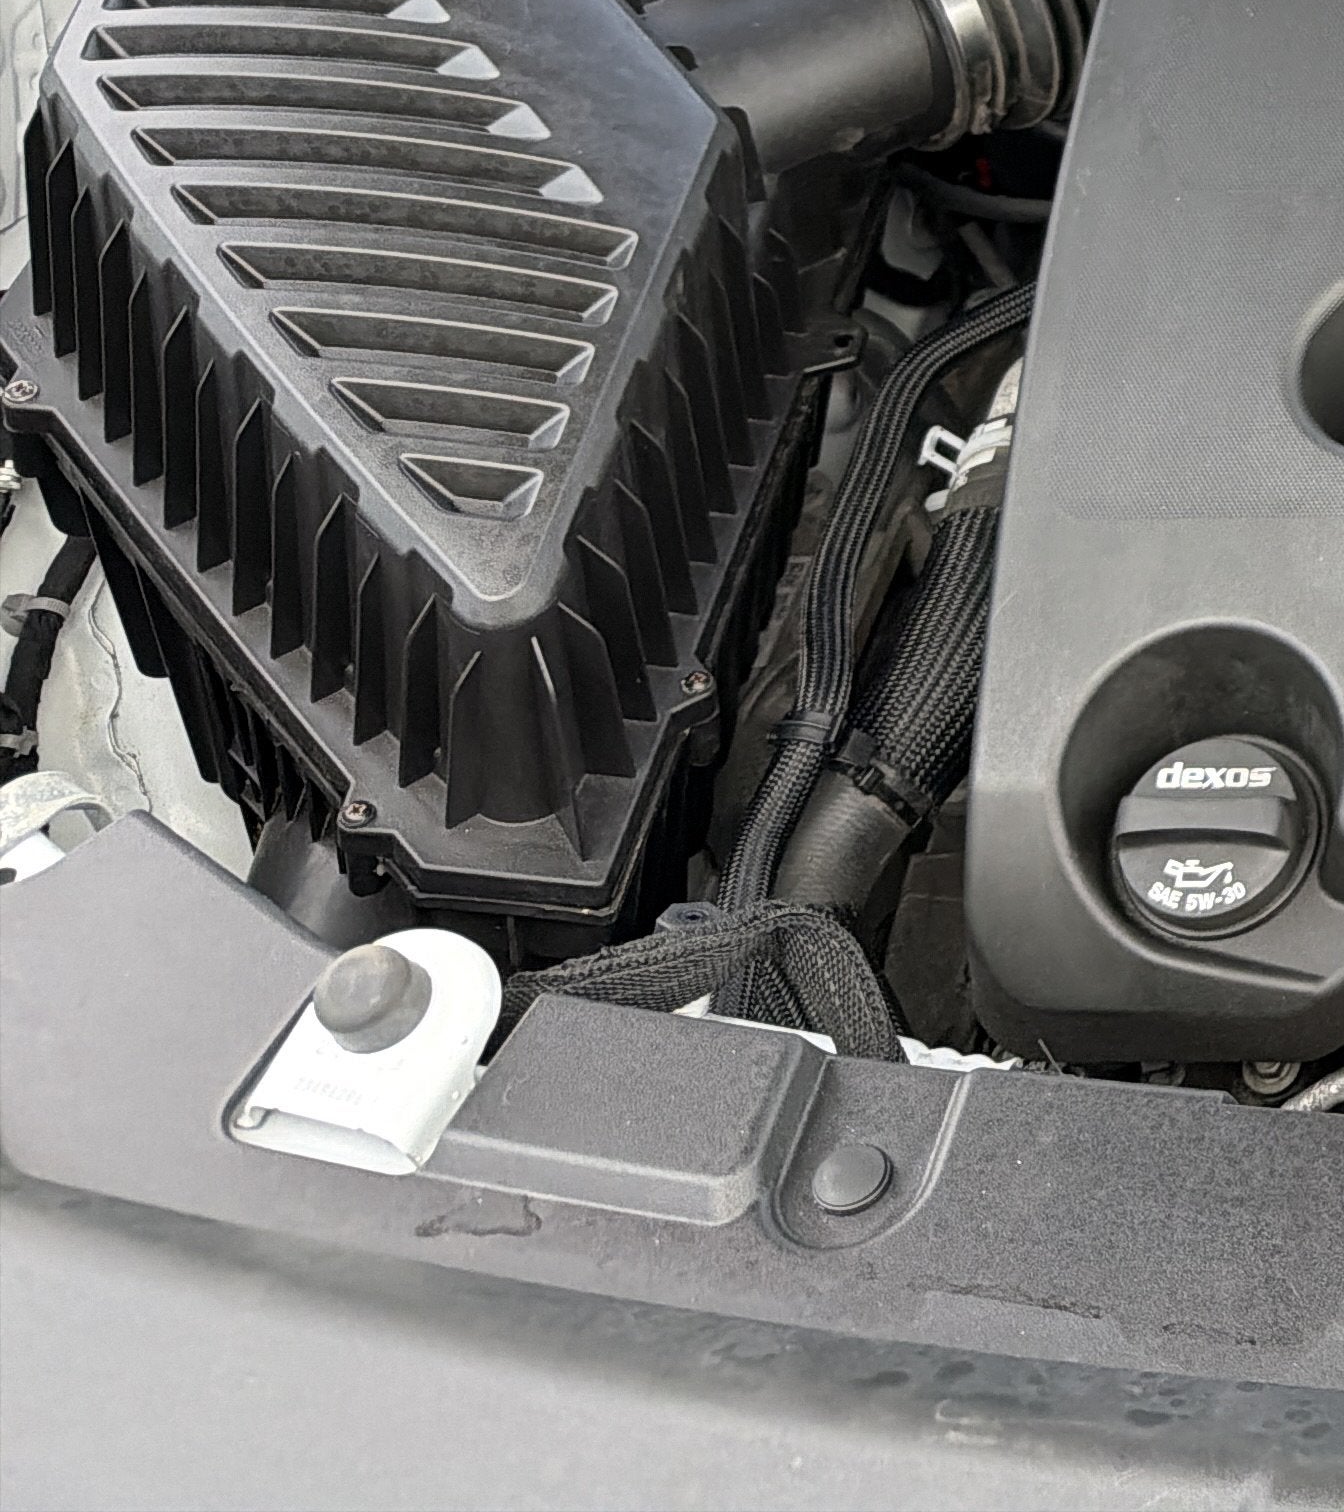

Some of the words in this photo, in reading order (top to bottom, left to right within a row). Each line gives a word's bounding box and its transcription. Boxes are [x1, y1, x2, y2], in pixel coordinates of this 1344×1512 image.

[1156, 762, 1277, 790] dexos
[1147, 881, 1183, 910] SAE
[1185, 881, 1246, 912] 5W-30
